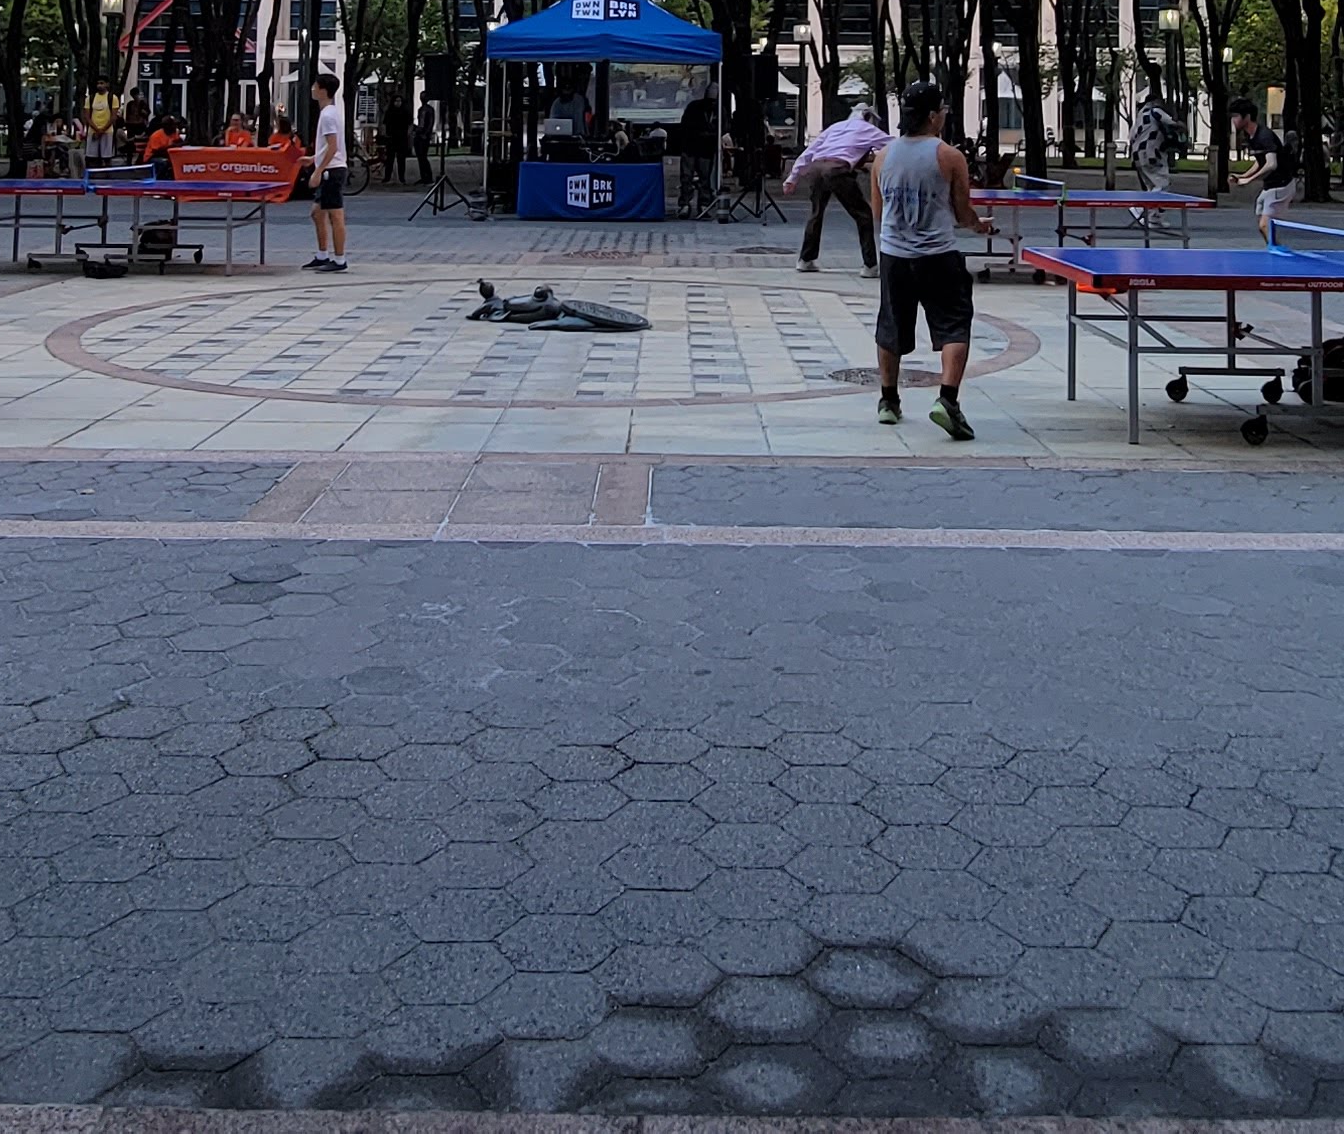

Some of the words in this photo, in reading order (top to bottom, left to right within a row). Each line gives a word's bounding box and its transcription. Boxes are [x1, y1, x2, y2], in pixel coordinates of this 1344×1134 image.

[575, 0, 600, 9] DWN
[609, 0, 637, 11] BRK
[575, 9, 600, 17] TWN
[609, 9, 637, 18] LYN
[221, 162, 279, 174] organics.
[593, 179, 612, 191] BRK
[593, 192, 612, 204] LYN
